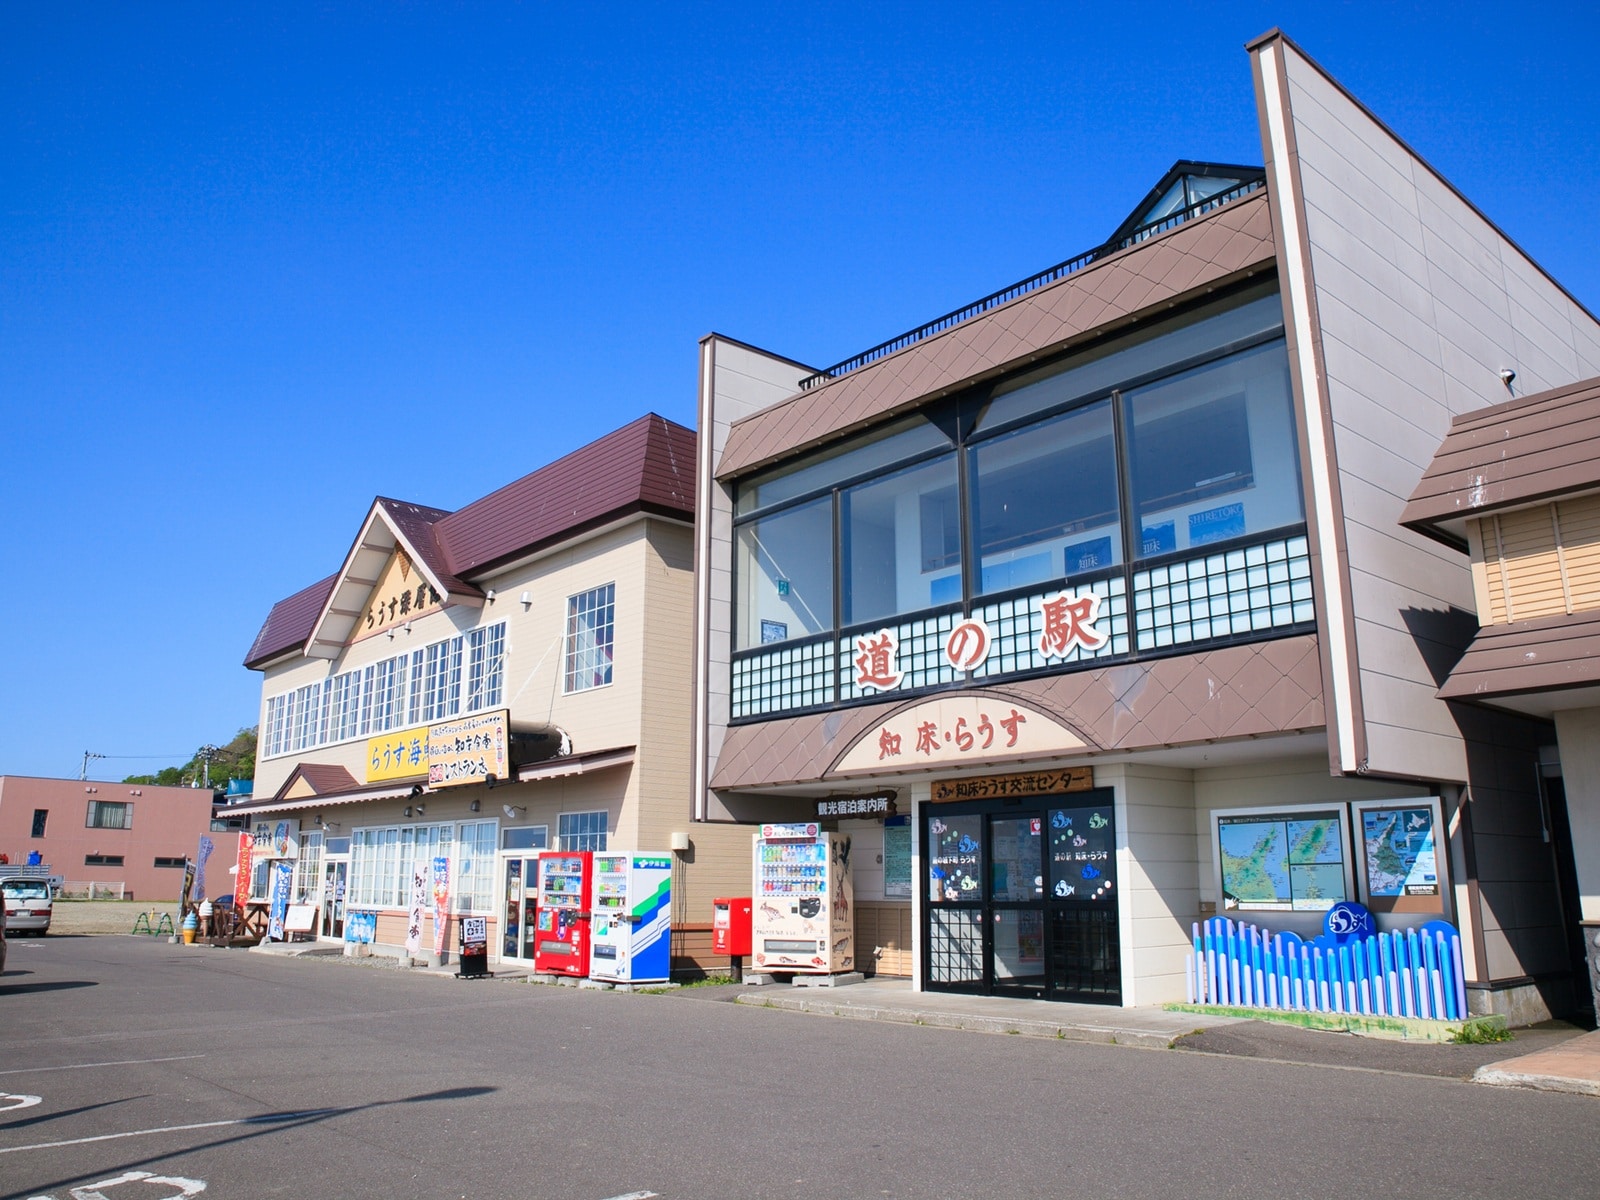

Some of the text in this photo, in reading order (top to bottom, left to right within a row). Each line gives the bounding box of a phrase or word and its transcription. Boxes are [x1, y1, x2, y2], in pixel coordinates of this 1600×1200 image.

[1078, 555, 1098, 570] 知床
[855, 595, 1102, 687] 道の駅
[879, 709, 1026, 760] 知床・らうす
[956, 772, 1085, 797] 知床らうす交流センター
[818, 798, 888, 815] 観光宿泊案内所
[960, 856, 976, 864] らうす
